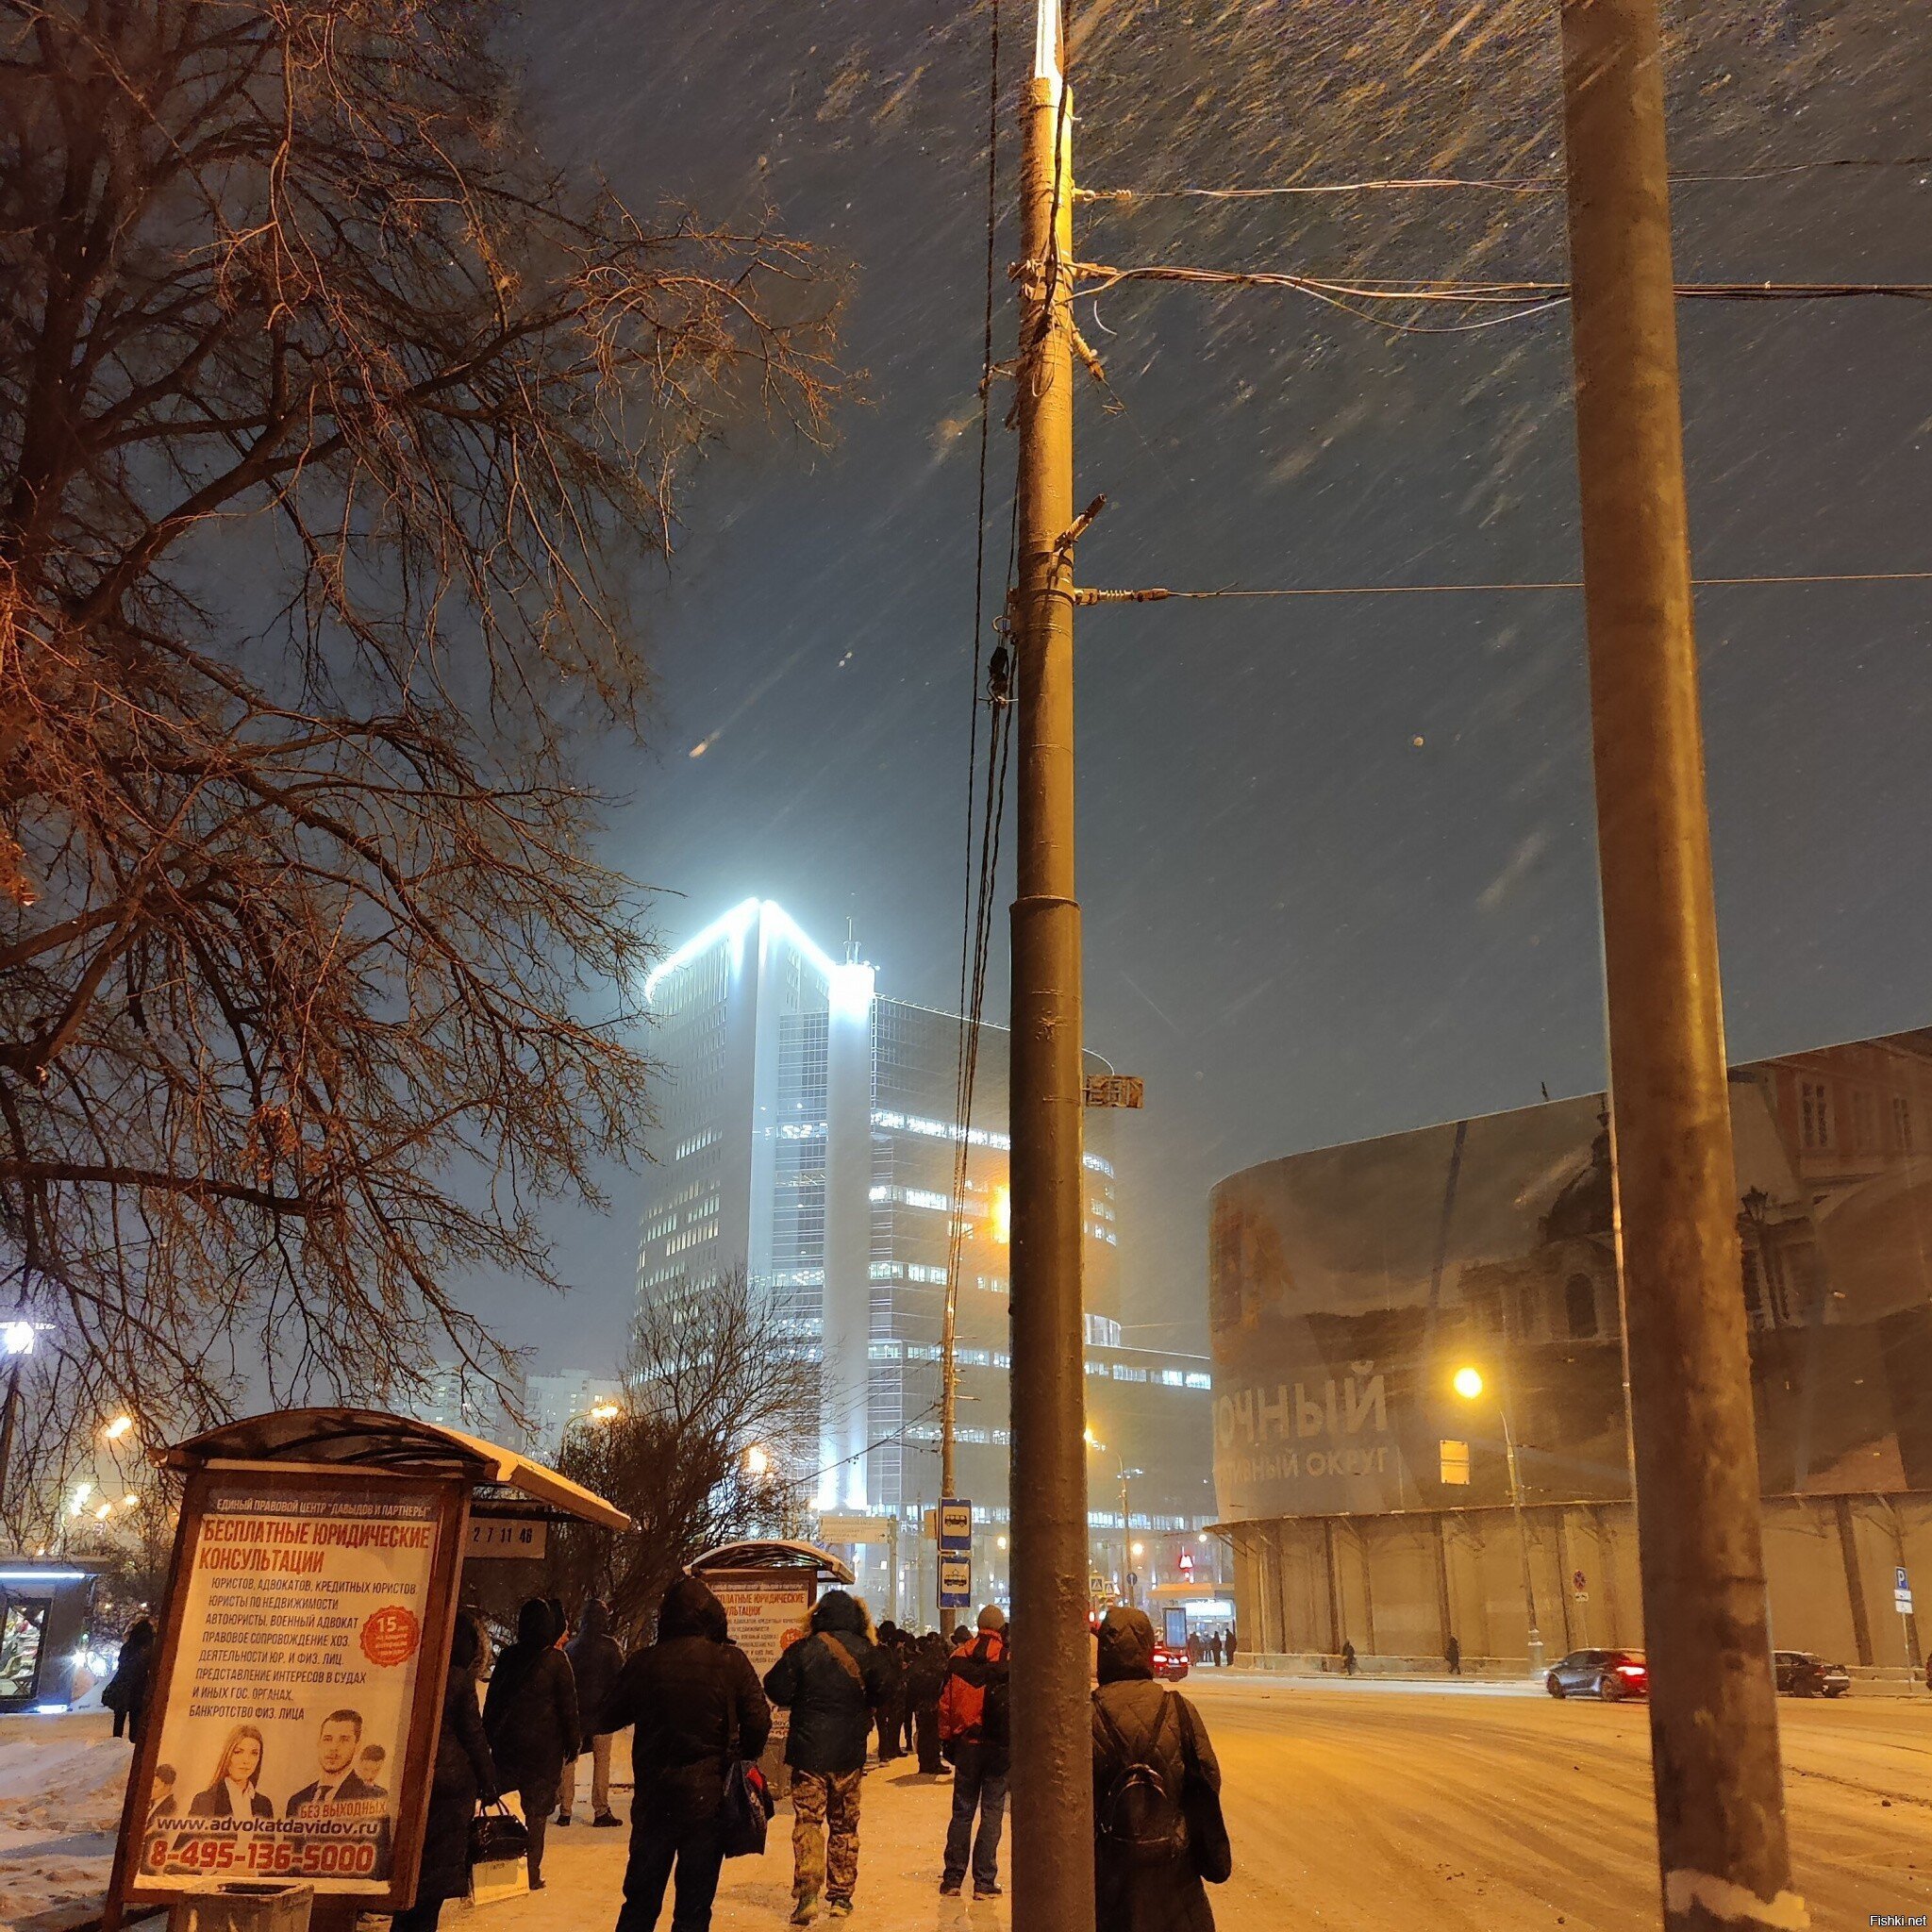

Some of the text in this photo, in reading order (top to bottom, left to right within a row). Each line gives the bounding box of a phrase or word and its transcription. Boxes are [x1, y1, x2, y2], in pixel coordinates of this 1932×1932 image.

[1213, 1360, 1388, 1448] ОЧНЫЙ
[1306, 1446, 1389, 1477] ОКРУГ
[217, 1498, 253, 1512] ЕДИНЫЙ
[254, 1499, 299, 1513] ПРАВОВОЙ
[300, 1502, 326, 1515] ЦЕНТР
[375, 1505, 381, 1515] И
[204, 1519, 431, 1549] БЕСПЛАТНЫЕ ЮРИДИЧЕСКИЕ
[474, 1527, 480, 1542] 2
[487, 1527, 494, 1542] 7
[501, 1528, 512, 1543] 11
[198, 1547, 325, 1574] КОНСУЛЬТАЦИИ
[1897, 1570, 1906, 1587] P
[315, 1581, 372, 1594] КРЕДИТНЫХ
[208, 1595, 339, 1610] ЮРИСТЫ ПО НЕДВИЖИМОСТИ
[717, 1592, 805, 1604] СПЛАТНЫЕ ЮРИДИЧЕСКИЕ
[725, 1606, 762, 1616] УЛЬТАЦИИ
[270, 1614, 315, 1627] ВОЕННЫЙ
[316, 1617, 359, 1629] АДВОКАТ
[377, 1617, 396, 1633] 15
[202, 1631, 350, 1647] ПРАВОВОЕ СОПРОВОЖДЕНИЕ ХОЗ.
[198, 1650, 344, 1666] ДЕЯТЕЛЬНОСТИ ЮР. И ФИЗ. ЛИЦ.
[196, 1668, 367, 1685] ПРЕДСТАВЛЕНИЕ ИНТЕРЕСОВ В СУДАХ
[192, 1687, 200, 1698] И
[201, 1687, 229, 1699] ИНЫХ
[230, 1688, 251, 1699] ГОС.
[189, 1705, 305, 1721] БАНКРОТСТВО ФИЗ. ЛИЦА
[300, 1800, 388, 1819] БЕЗ ВЫХОДНЫХ
[157, 1816, 378, 1835] www.advokatdavidov.ru
[150, 1840, 375, 1873] 8-495-136-5000
